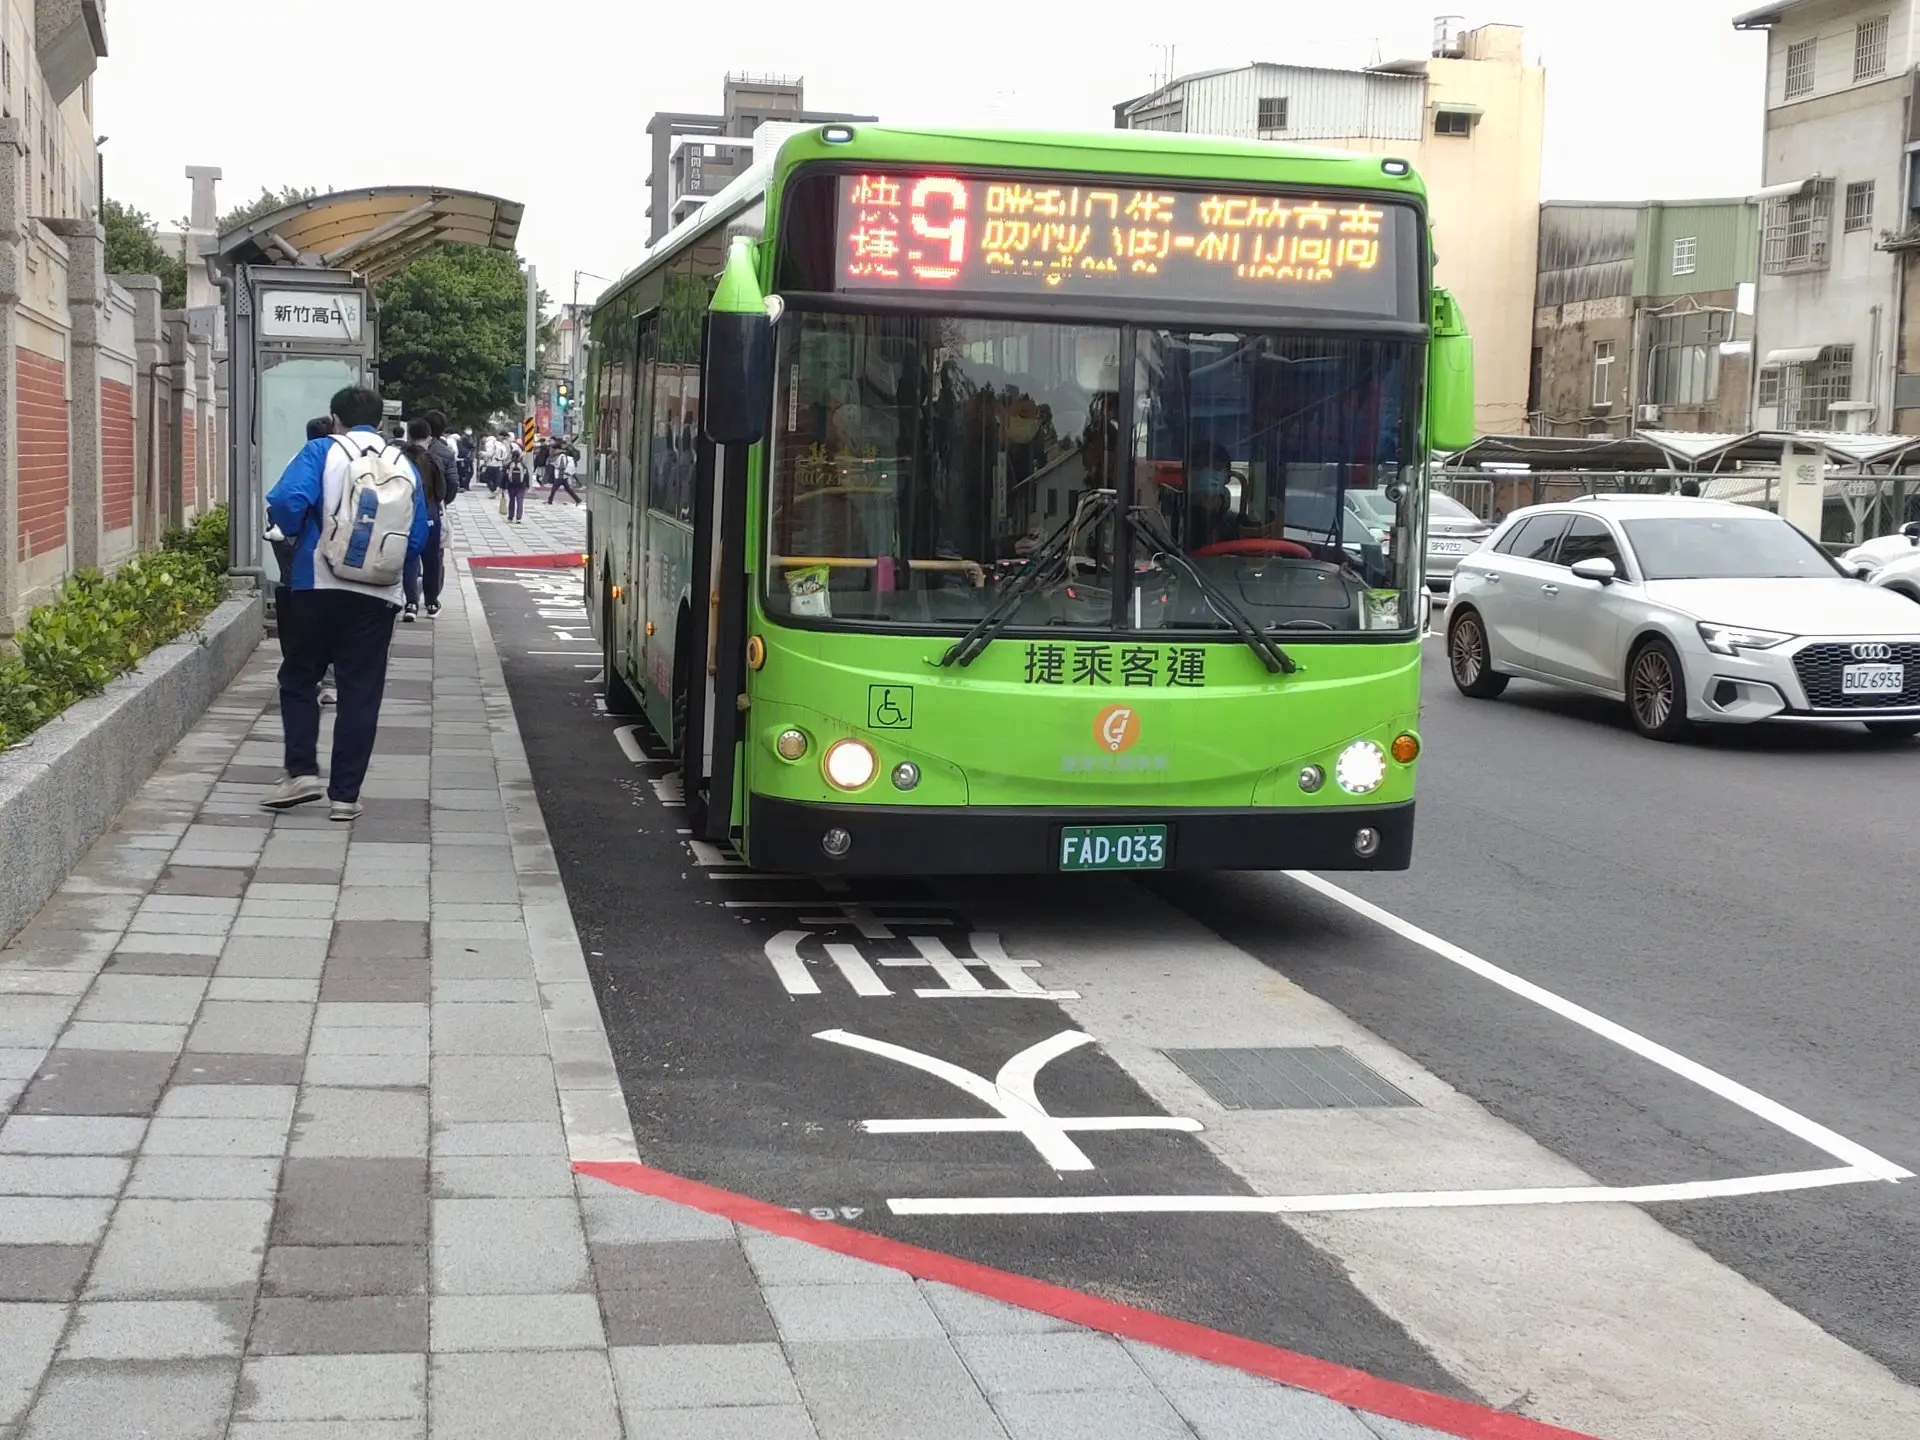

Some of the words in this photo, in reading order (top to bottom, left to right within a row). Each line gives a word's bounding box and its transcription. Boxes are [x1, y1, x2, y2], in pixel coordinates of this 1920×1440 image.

[911, 176, 967, 280] 9
[1024, 643, 1207, 688] 捷乘客運
